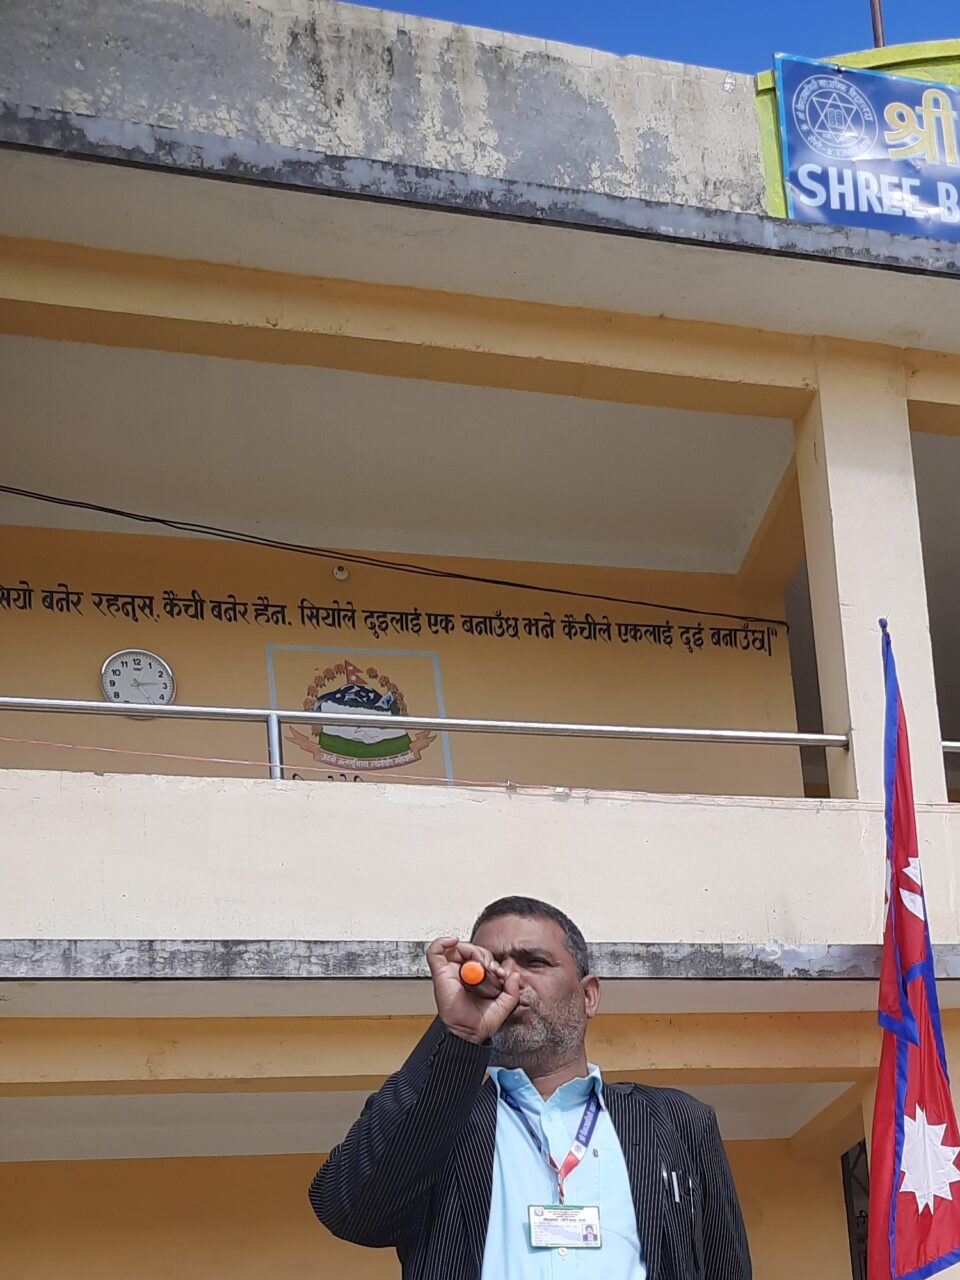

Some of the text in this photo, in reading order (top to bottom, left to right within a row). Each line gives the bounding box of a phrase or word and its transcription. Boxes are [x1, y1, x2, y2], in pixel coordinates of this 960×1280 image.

[884, 88, 958, 168] श्री
[799, 164, 928, 220] SHREE
[41, 583, 84, 616] बनेर
[209, 594, 250, 624] बनेर
[297, 598, 357, 629] सियोले
[425, 612, 455, 634] एक
[522, 612, 556, 639] भने
